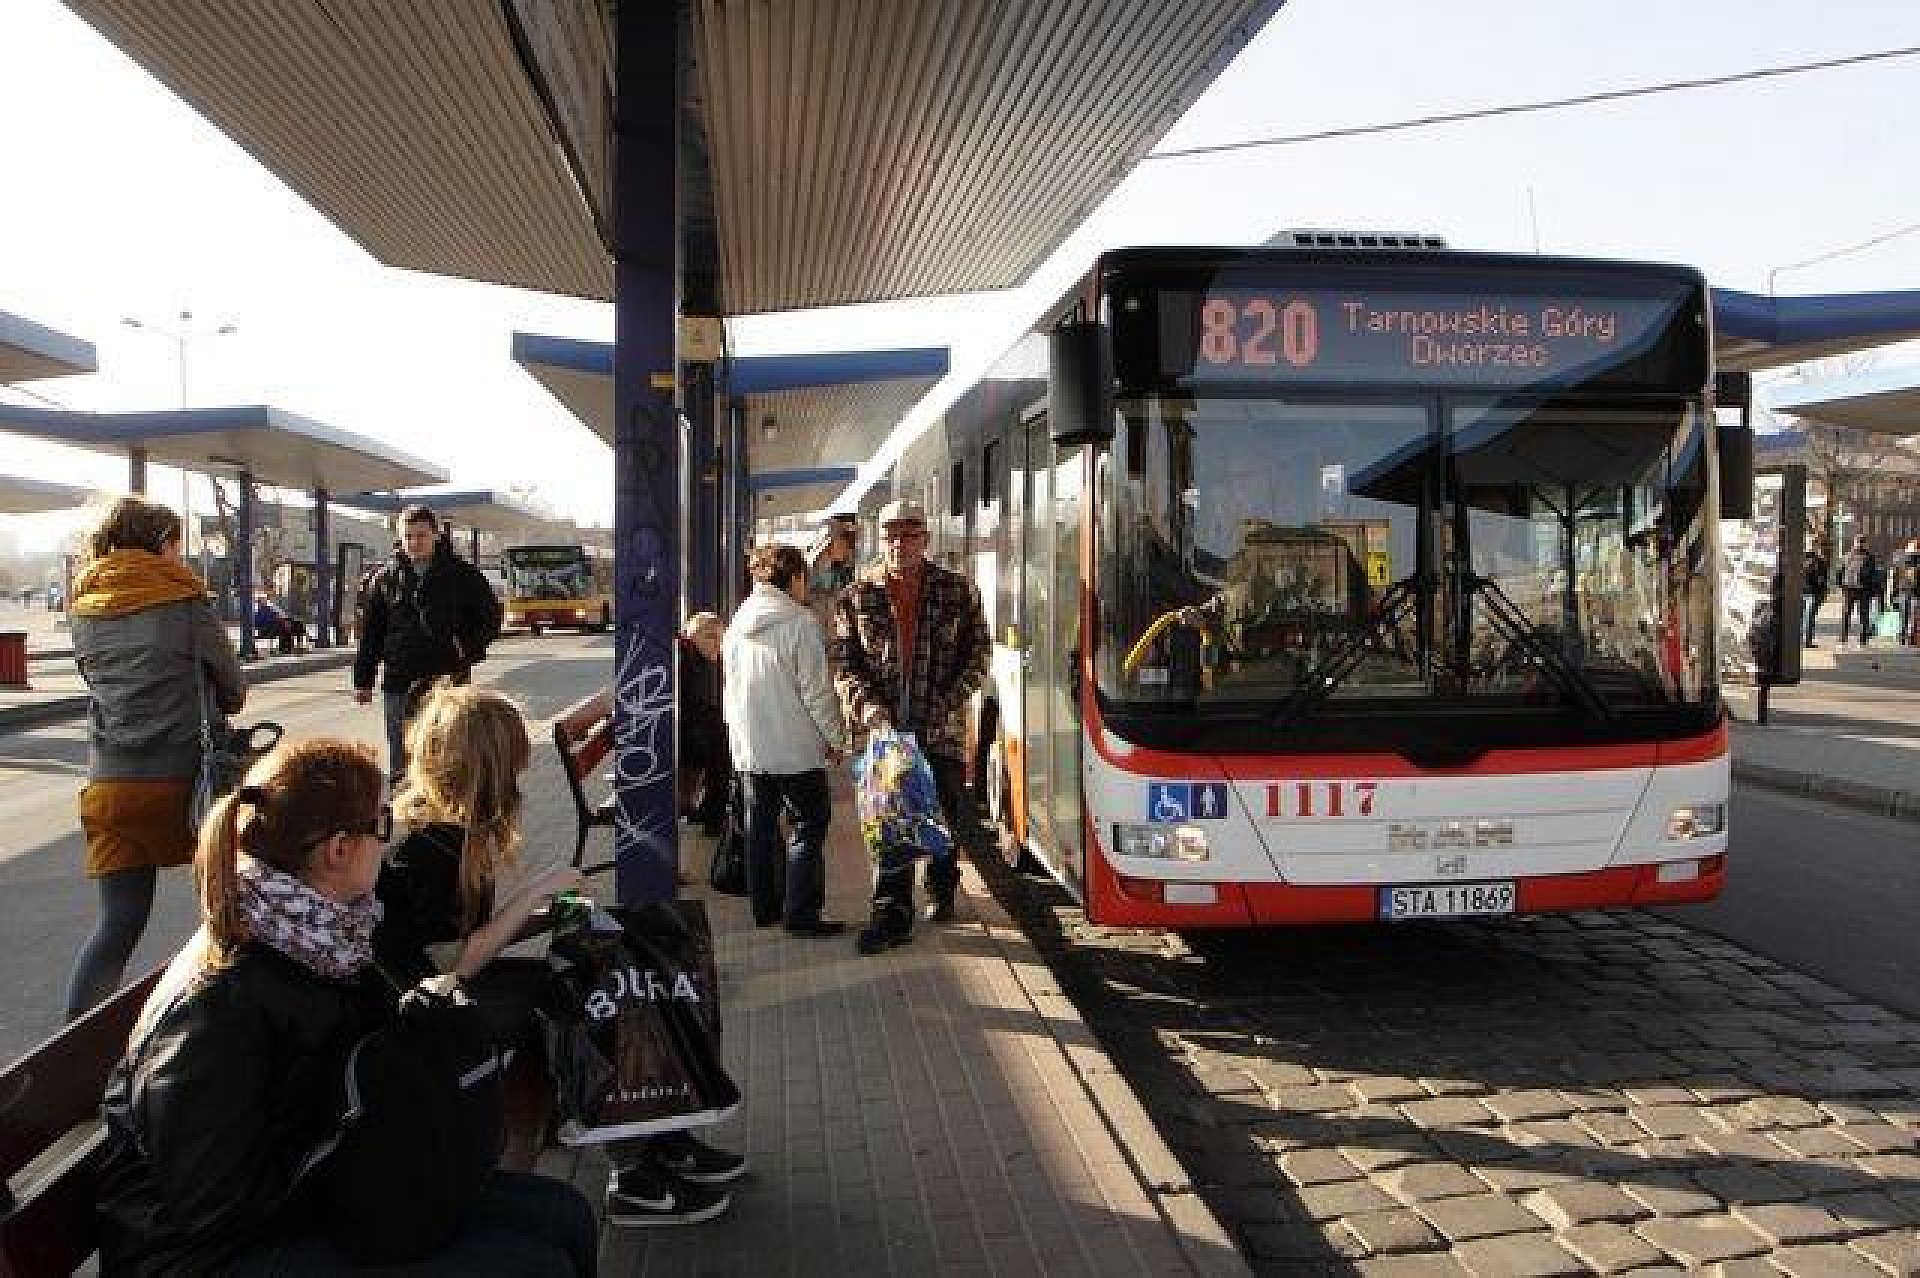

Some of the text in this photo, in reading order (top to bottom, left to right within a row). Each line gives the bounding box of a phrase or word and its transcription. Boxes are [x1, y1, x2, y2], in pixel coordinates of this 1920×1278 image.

[1201, 298, 1319, 367] 820
[1342, 301, 1617, 342] Tarnowskie Góry
[1410, 335, 1548, 367] Dworzec
[1266, 782, 1378, 817] 1117
[1394, 887, 1513, 915] STA 11869
